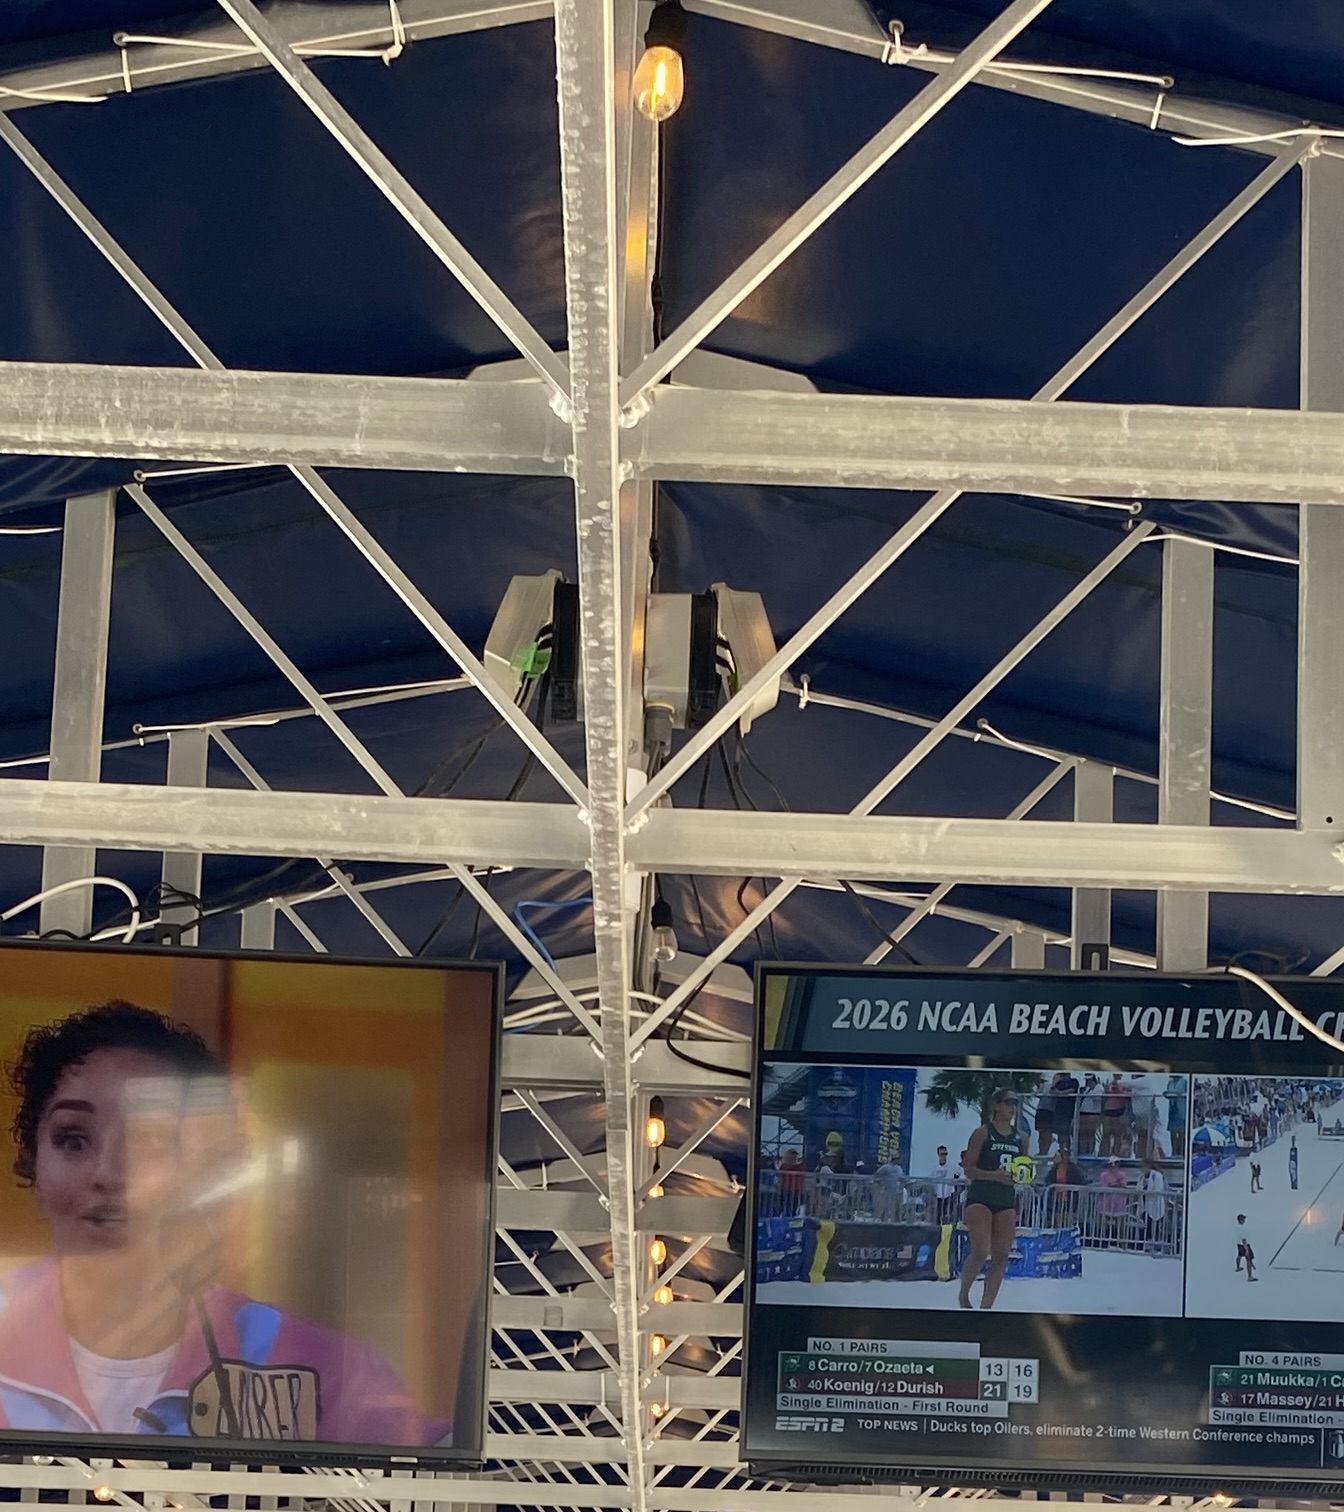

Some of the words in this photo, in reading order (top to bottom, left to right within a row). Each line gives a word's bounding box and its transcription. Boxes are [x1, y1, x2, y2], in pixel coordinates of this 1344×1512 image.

[831, 998, 910, 1031] 2026
[917, 1000, 999, 1034] NCAA
[1008, 1003, 1112, 1037] BEACH
[1121, 1006, 1305, 1042] VOLLEYBALL
[812, 1340, 834, 1352] NO.
[839, 1341, 845, 1352] 1
[850, 1342, 888, 1354] PAIRS
[808, 1361, 816, 1372] 8
[1244, 1354, 1269, 1366] NO.
[1272, 1355, 1280, 1366] 4
[1283, 1355, 1322, 1367] PAIRS
[985, 1363, 1004, 1377] 13
[1015, 1364, 1033, 1378] 16
[807, 1379, 823, 1391] 40
[896, 1381, 944, 1396] Durish
[1240, 1375, 1255, 1386] 21
[983, 1384, 1002, 1398] 21
[1014, 1385, 1033, 1399] 19
[780, 1396, 822, 1410] Single
[826, 1397, 900, 1412] Elimination
[912, 1400, 942, 1413] First
[945, 1401, 989, 1414] Round
[1240, 1394, 1255, 1405] 17
[858, 1418, 884, 1431] TOP
[884, 1420, 919, 1432] NEWS
[1212, 1410, 1255, 1425] Single
[1259, 1411, 1334, 1426] Elimination
[930, 1419, 968, 1433] Ducks
[970, 1421, 992, 1436] top
[1036, 1424, 1094, 1438] eliminate
[1096, 1426, 1137, 1439] 2-time
[1139, 1427, 1190, 1441] Western
[1192, 1428, 1264, 1443] Conference
[1266, 1429, 1316, 1445] champs
